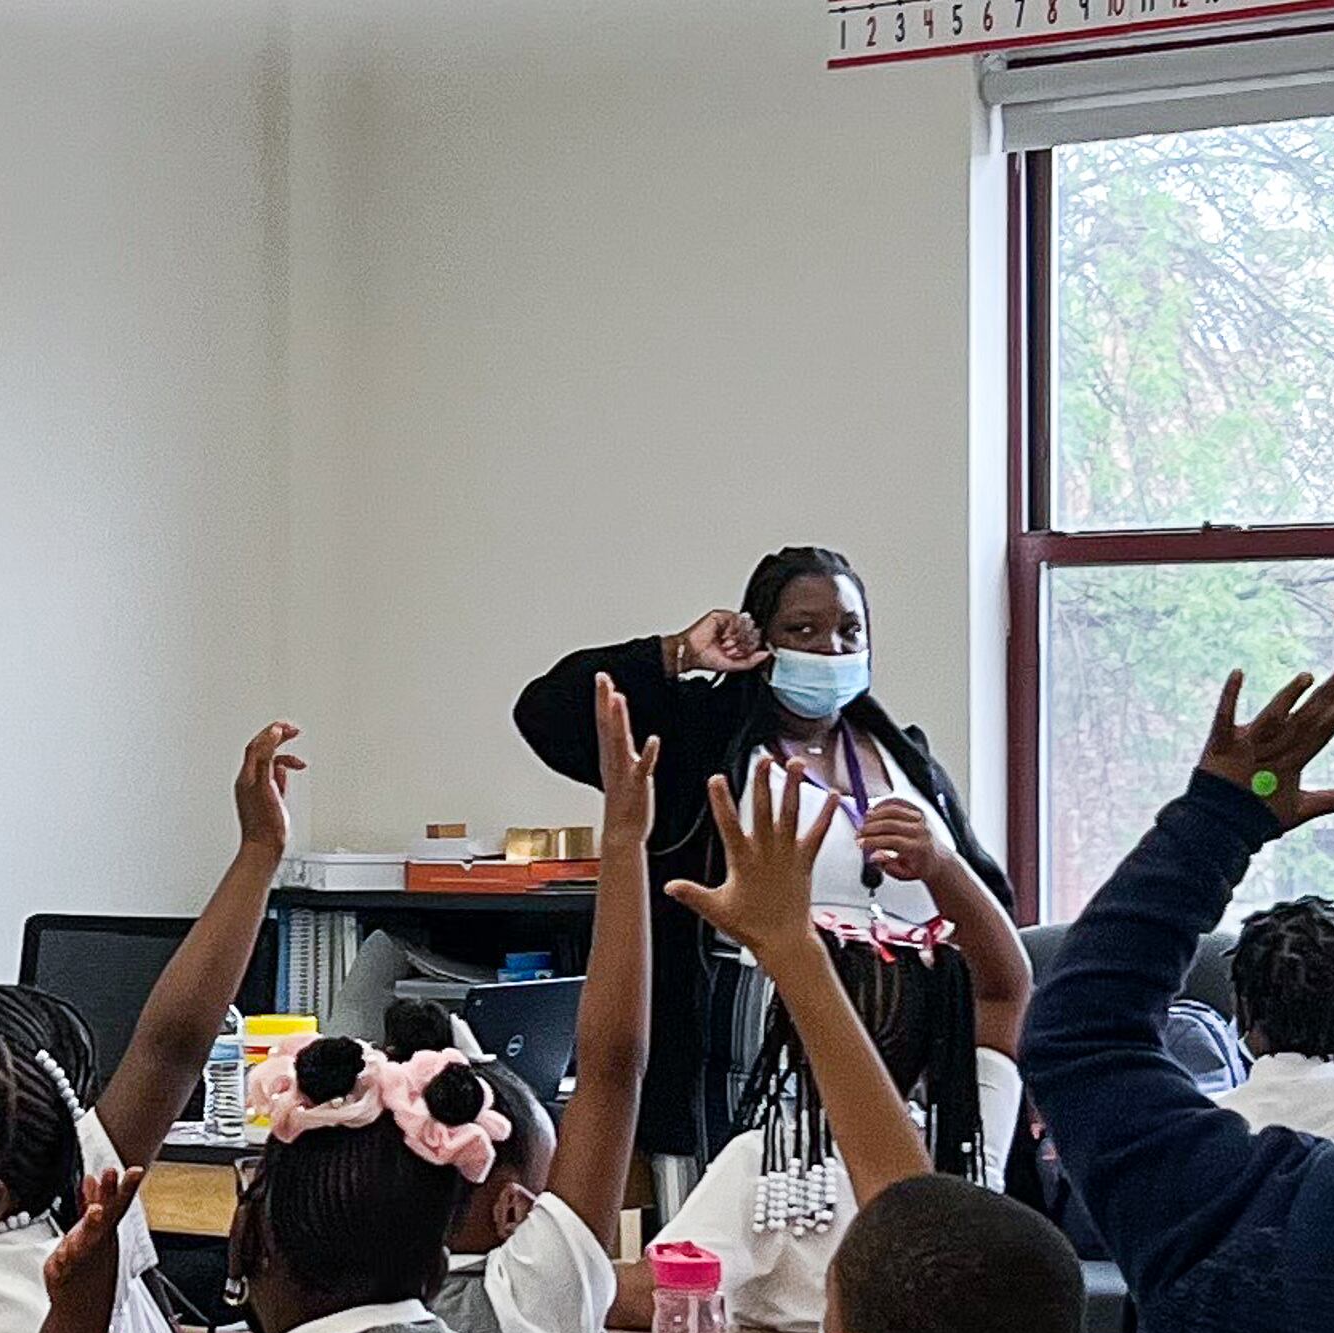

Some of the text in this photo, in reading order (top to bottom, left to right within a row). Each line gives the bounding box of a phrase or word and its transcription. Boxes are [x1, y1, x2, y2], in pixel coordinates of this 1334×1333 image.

[839, 20, 847, 50] 1
[866, 16, 877, 47] 2
[894, 12, 907, 42] 3
[923, 9, 934, 39] 4
[951, 4, 964, 35] 5
[982, 0, 994, 32] 6
[1014, 0, 1025, 28] 7
[1046, 0, 1058, 25] 8
